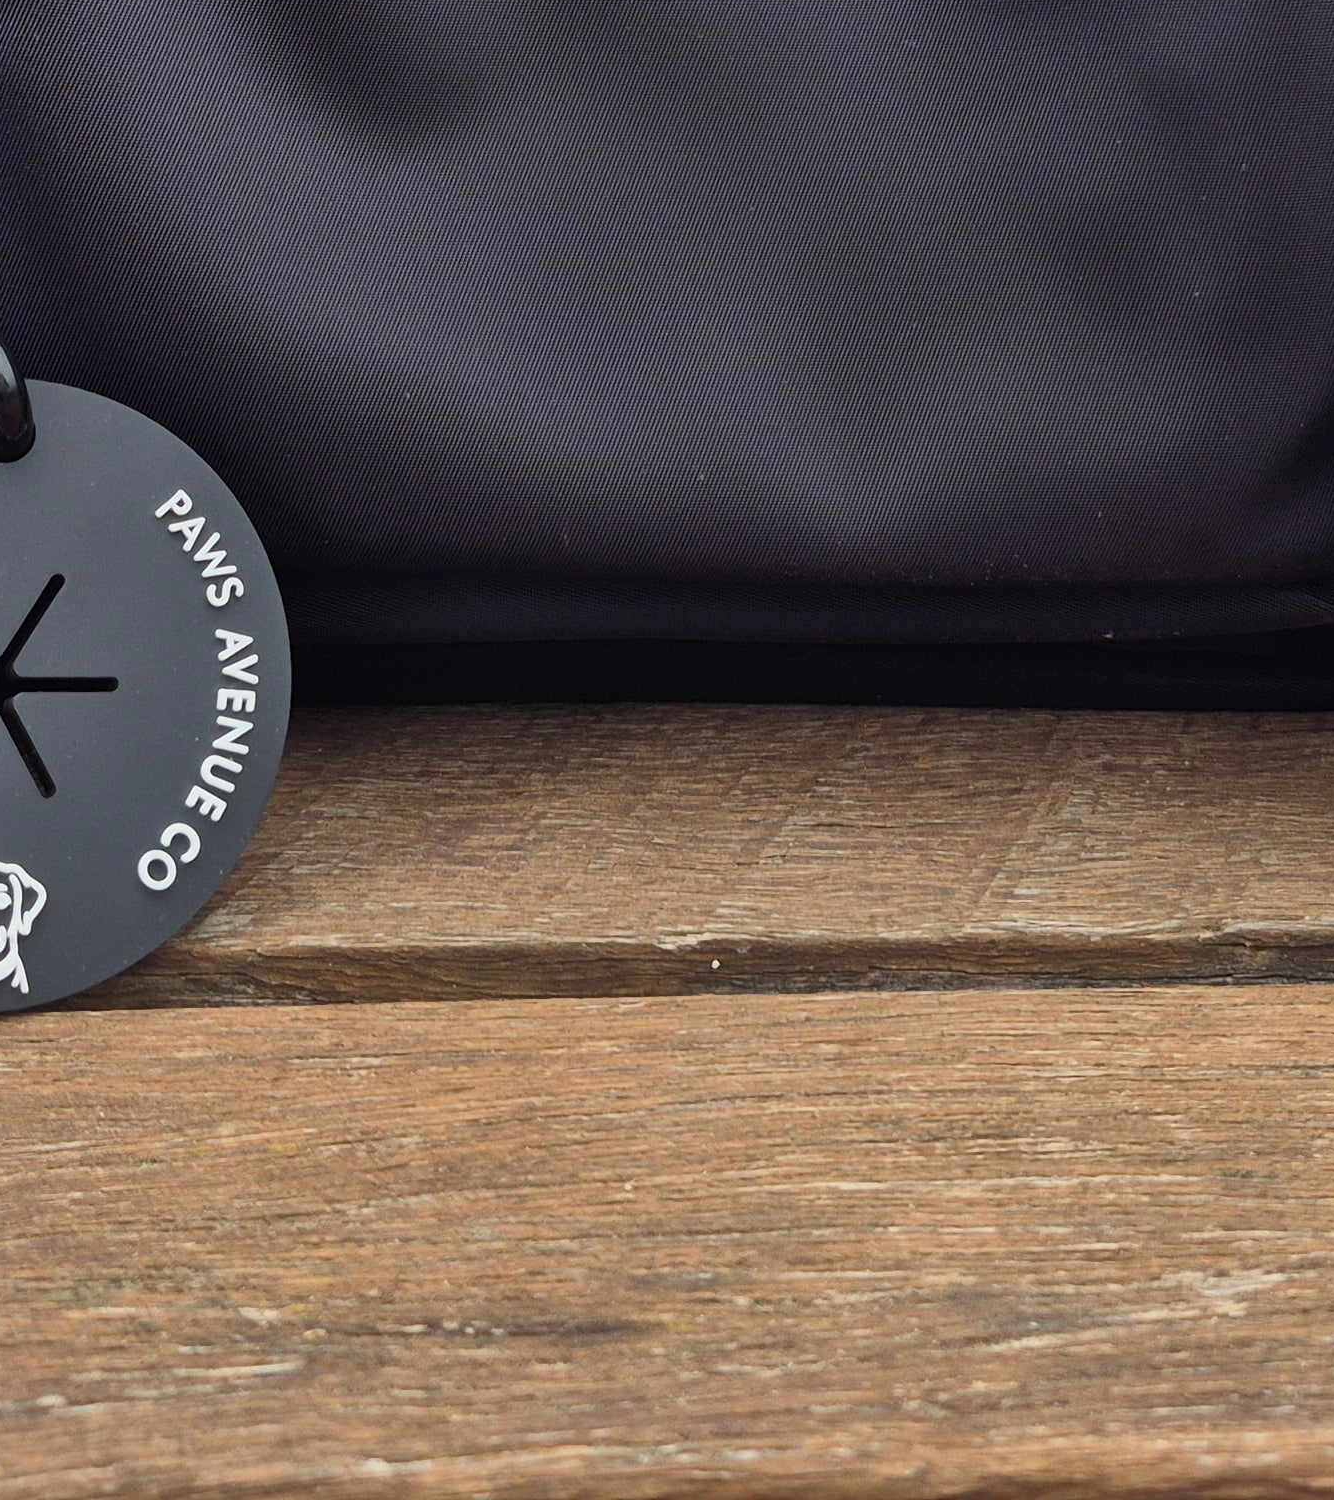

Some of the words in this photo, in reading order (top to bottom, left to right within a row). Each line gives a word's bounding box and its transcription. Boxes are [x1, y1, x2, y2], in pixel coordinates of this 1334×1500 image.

[154, 488, 244, 608] PAWS
[185, 627, 260, 822] AVENUE
[137, 822, 202, 891] CO
